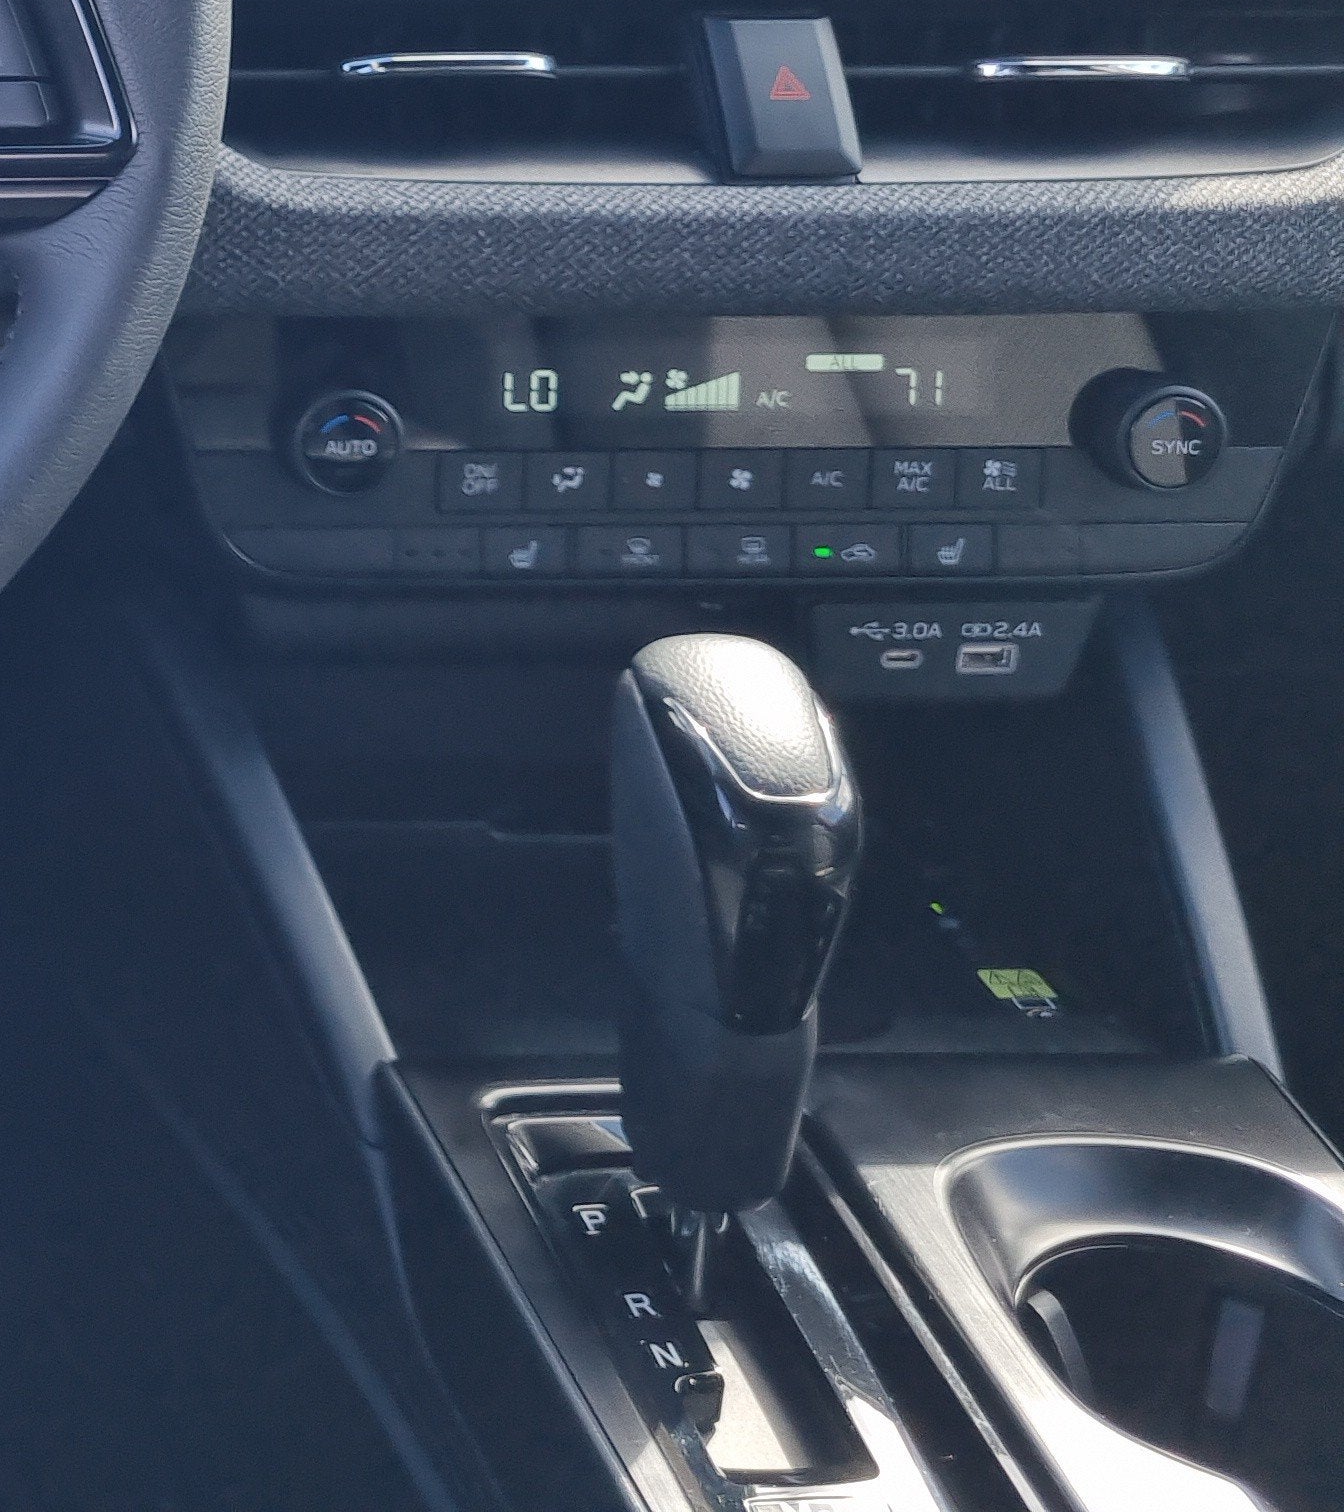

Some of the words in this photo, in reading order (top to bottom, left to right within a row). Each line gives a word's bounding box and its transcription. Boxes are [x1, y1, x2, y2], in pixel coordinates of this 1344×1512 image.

[503, 369, 558, 413] LO
[895, 368, 944, 406] 71
[756, 390, 791, 409] A/C
[325, 439, 377, 457] AUTO
[1151, 439, 1200, 456] SYNC
[894, 461, 933, 476] MAX
[811, 470, 846, 487] A/C
[896, 477, 930, 492] A/C
[981, 477, 1016, 492] ALL
[892, 622, 943, 639] 3.0A
[993, 621, 1042, 639] 2.4A
[578, 1209, 606, 1236] P
[625, 1293, 659, 1318] R
[649, 1342, 683, 1369] N
